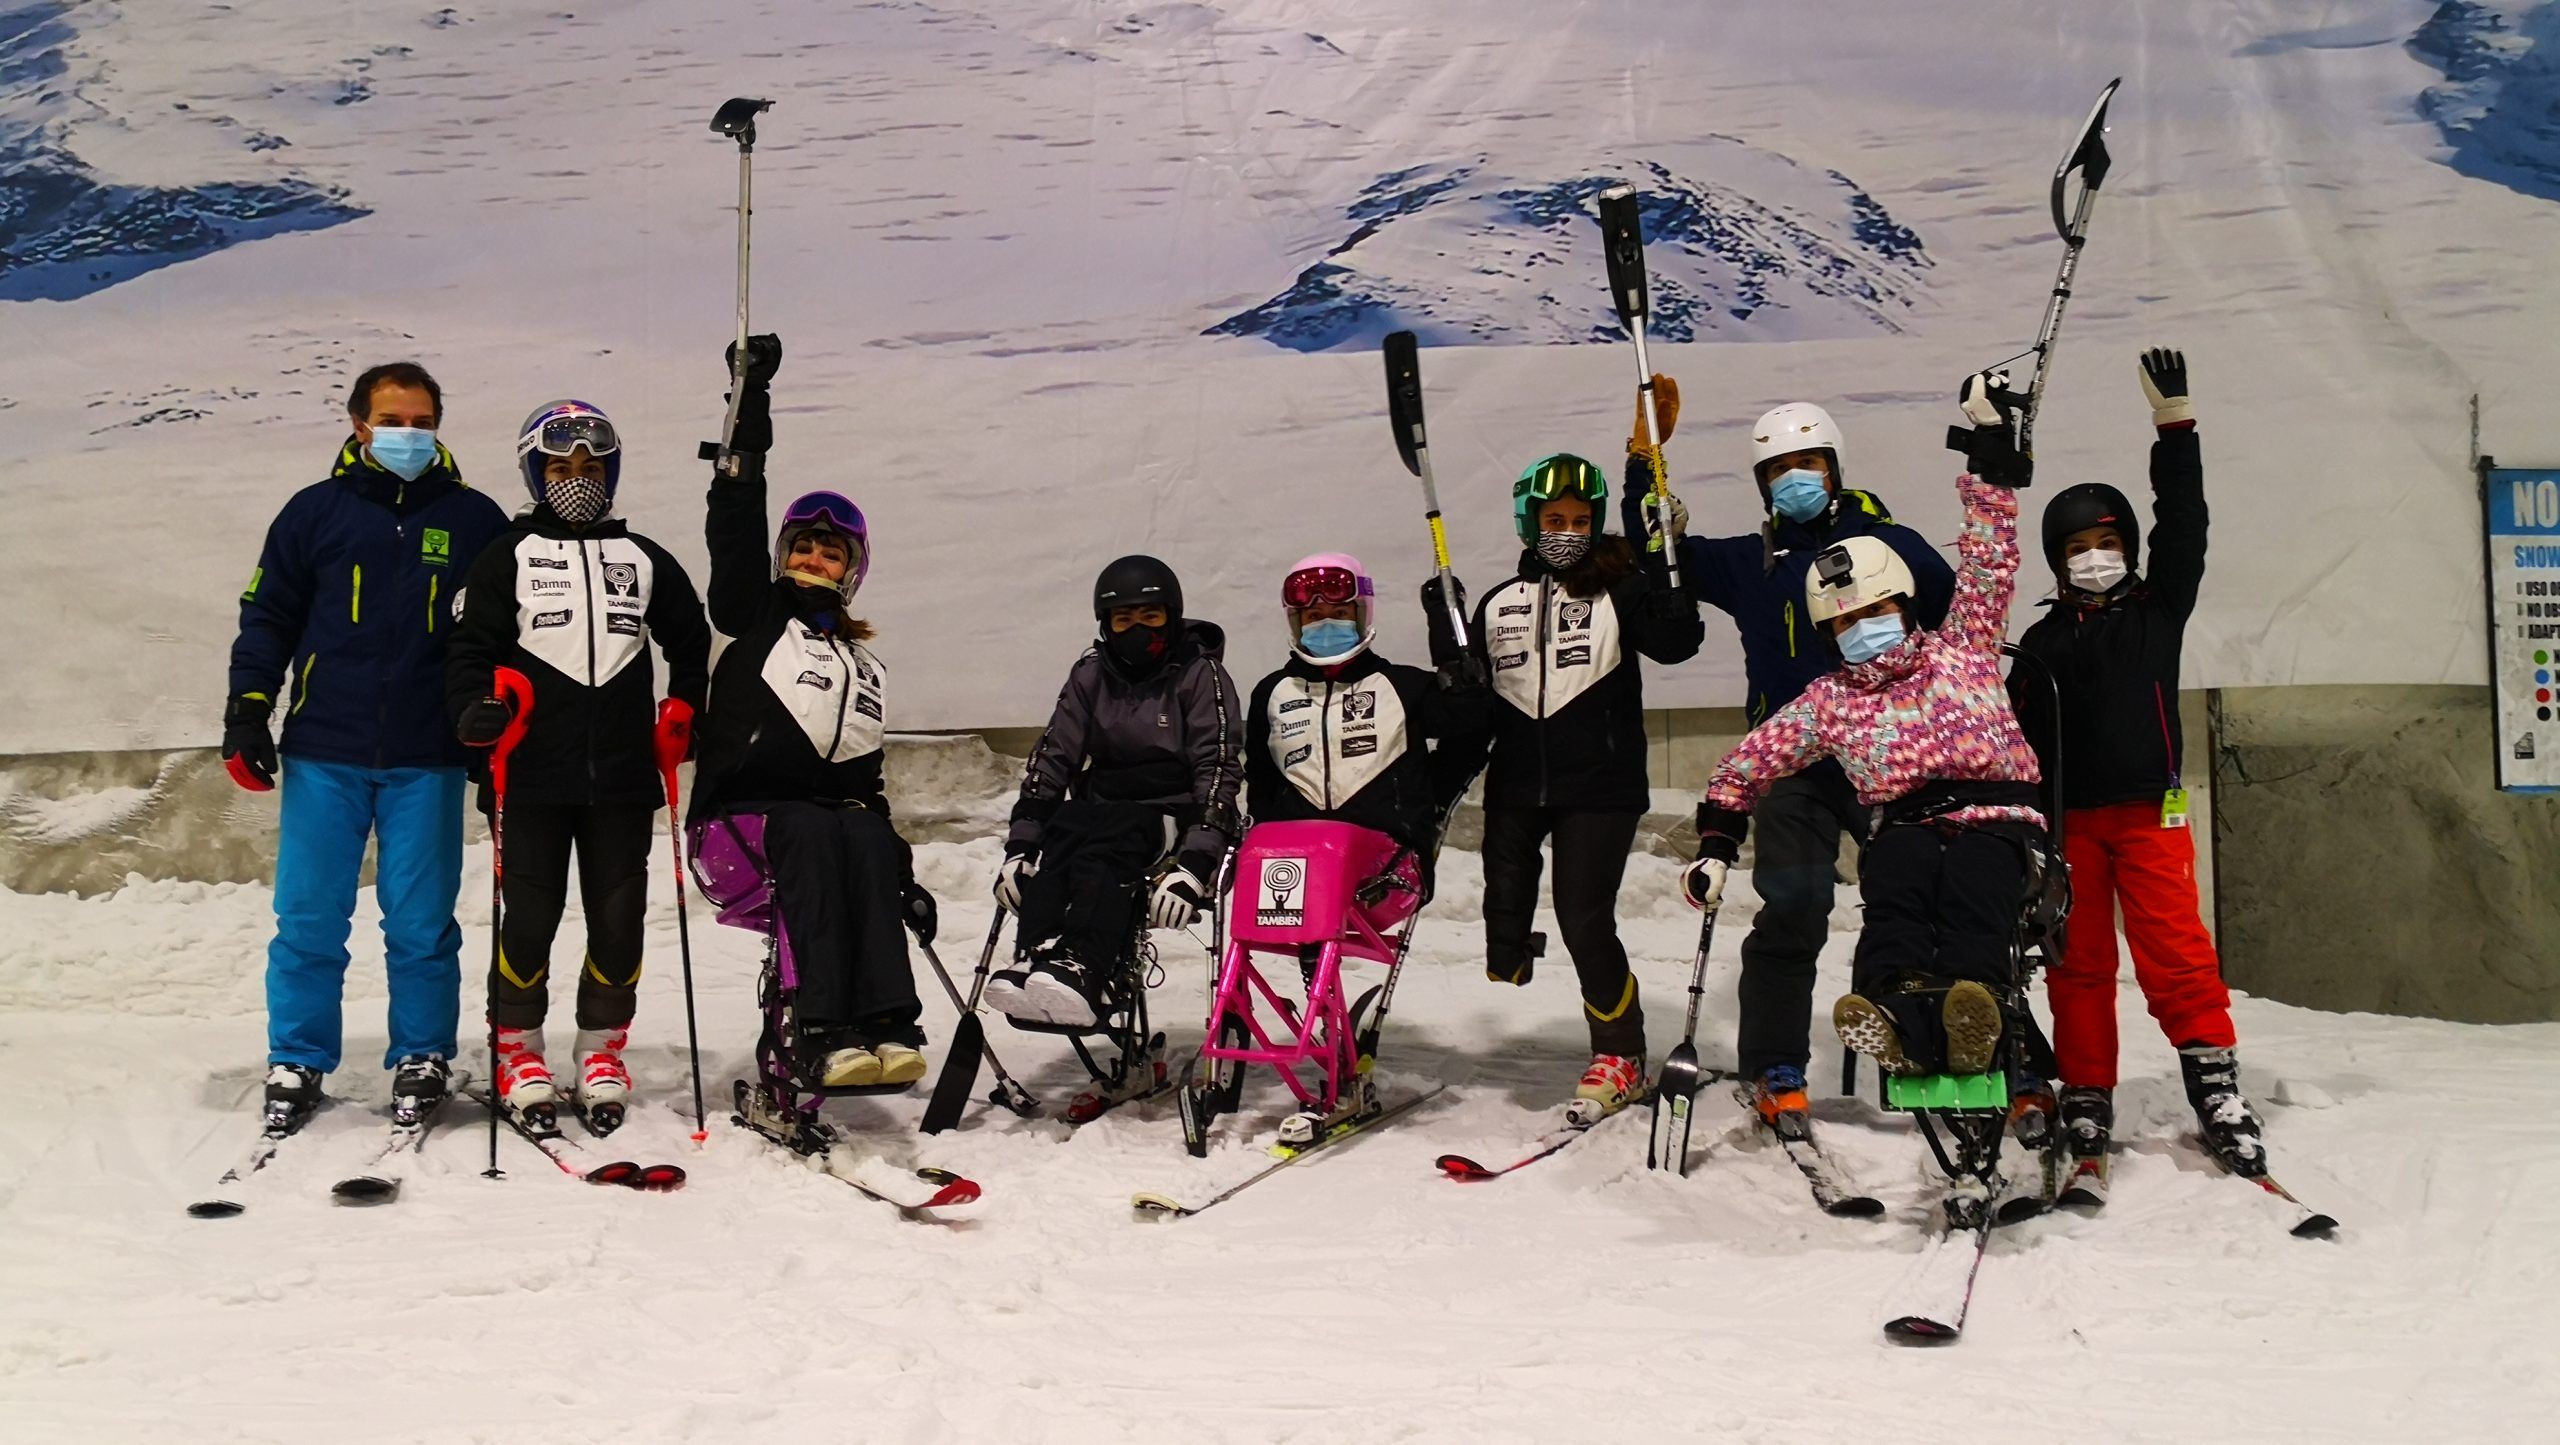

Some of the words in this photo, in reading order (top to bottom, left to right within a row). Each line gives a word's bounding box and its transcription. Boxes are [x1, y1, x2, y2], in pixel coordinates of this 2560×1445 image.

[2512, 480, 2559, 528] NO
[531, 579, 572, 591] Damm
[2525, 581, 2547, 596] USO
[2526, 603, 2541, 618] NO
[1496, 626, 1530, 637] Damm
[1280, 719, 1311, 734] Damm
[1256, 915, 1303, 927] TAMBIEN
